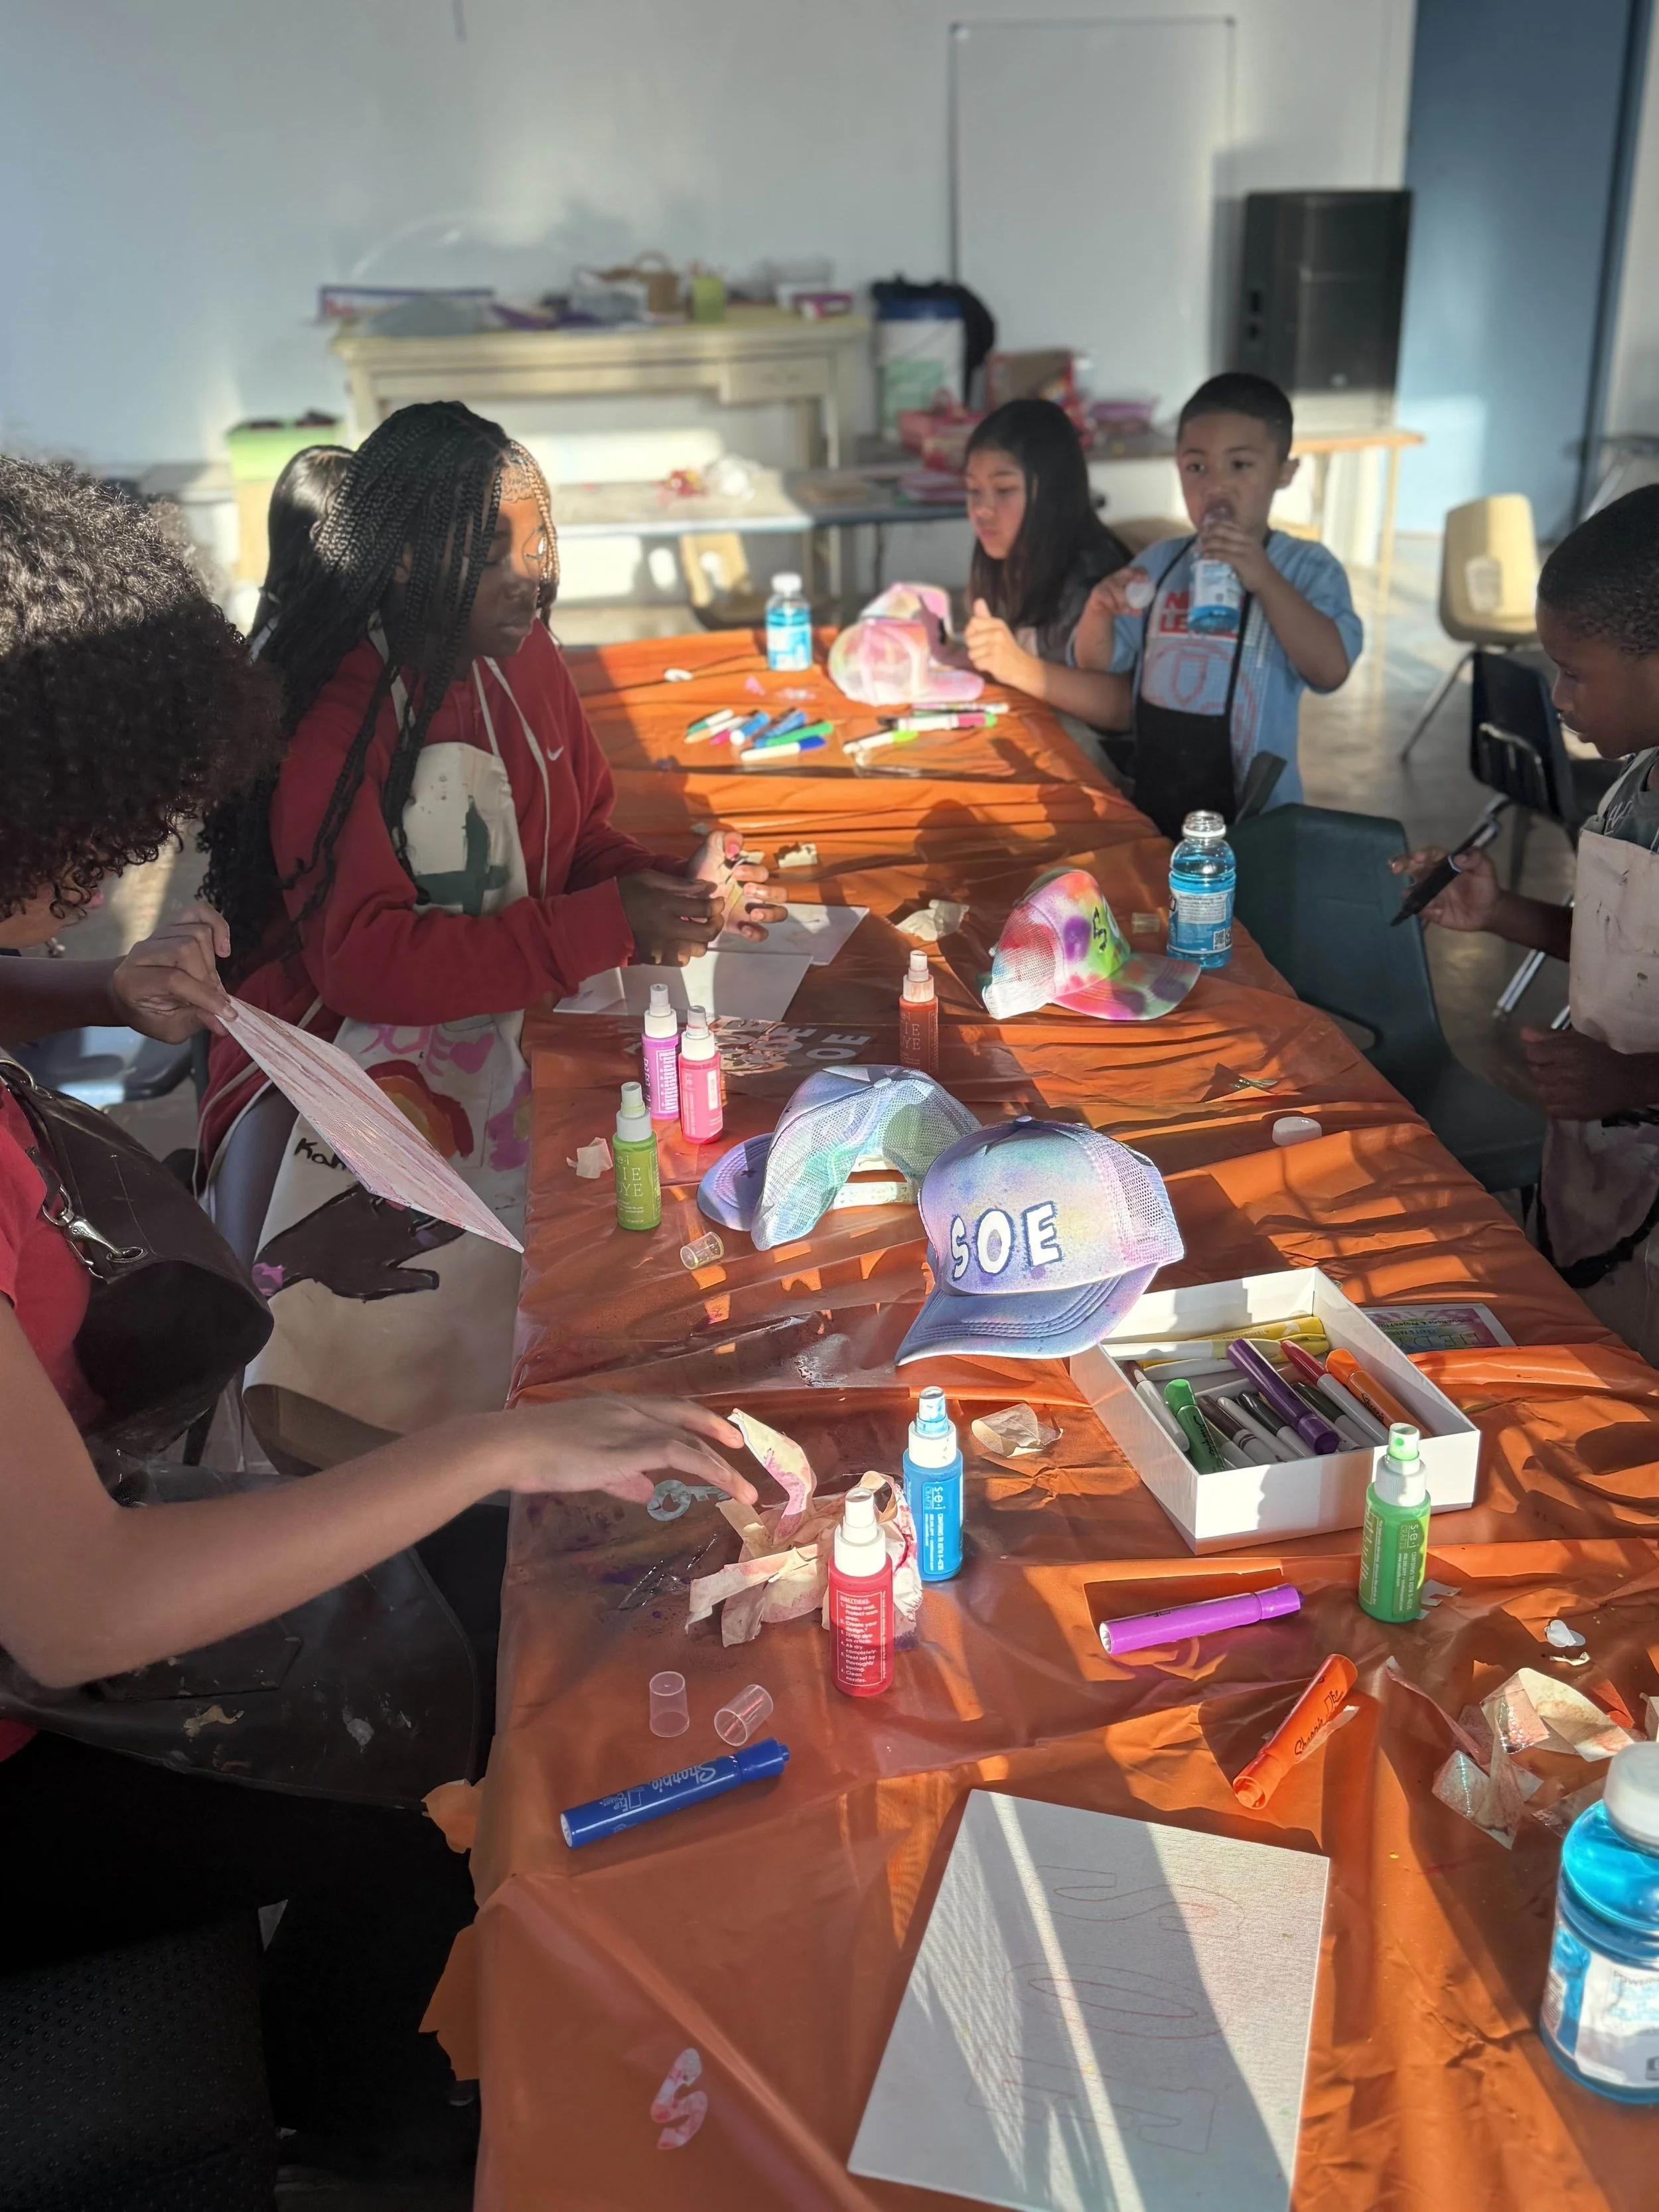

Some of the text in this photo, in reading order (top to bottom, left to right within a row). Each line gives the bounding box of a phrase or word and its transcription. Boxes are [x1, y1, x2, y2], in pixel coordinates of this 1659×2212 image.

[904, 1022, 920, 1036] IE
[950, 1200, 1065, 1282] SOE
[1396, 1333, 1486, 1350] TIE DY
[1400, 1524, 1408, 1550] CRAFTS
[652, 1763, 716, 1793] Sharpie
